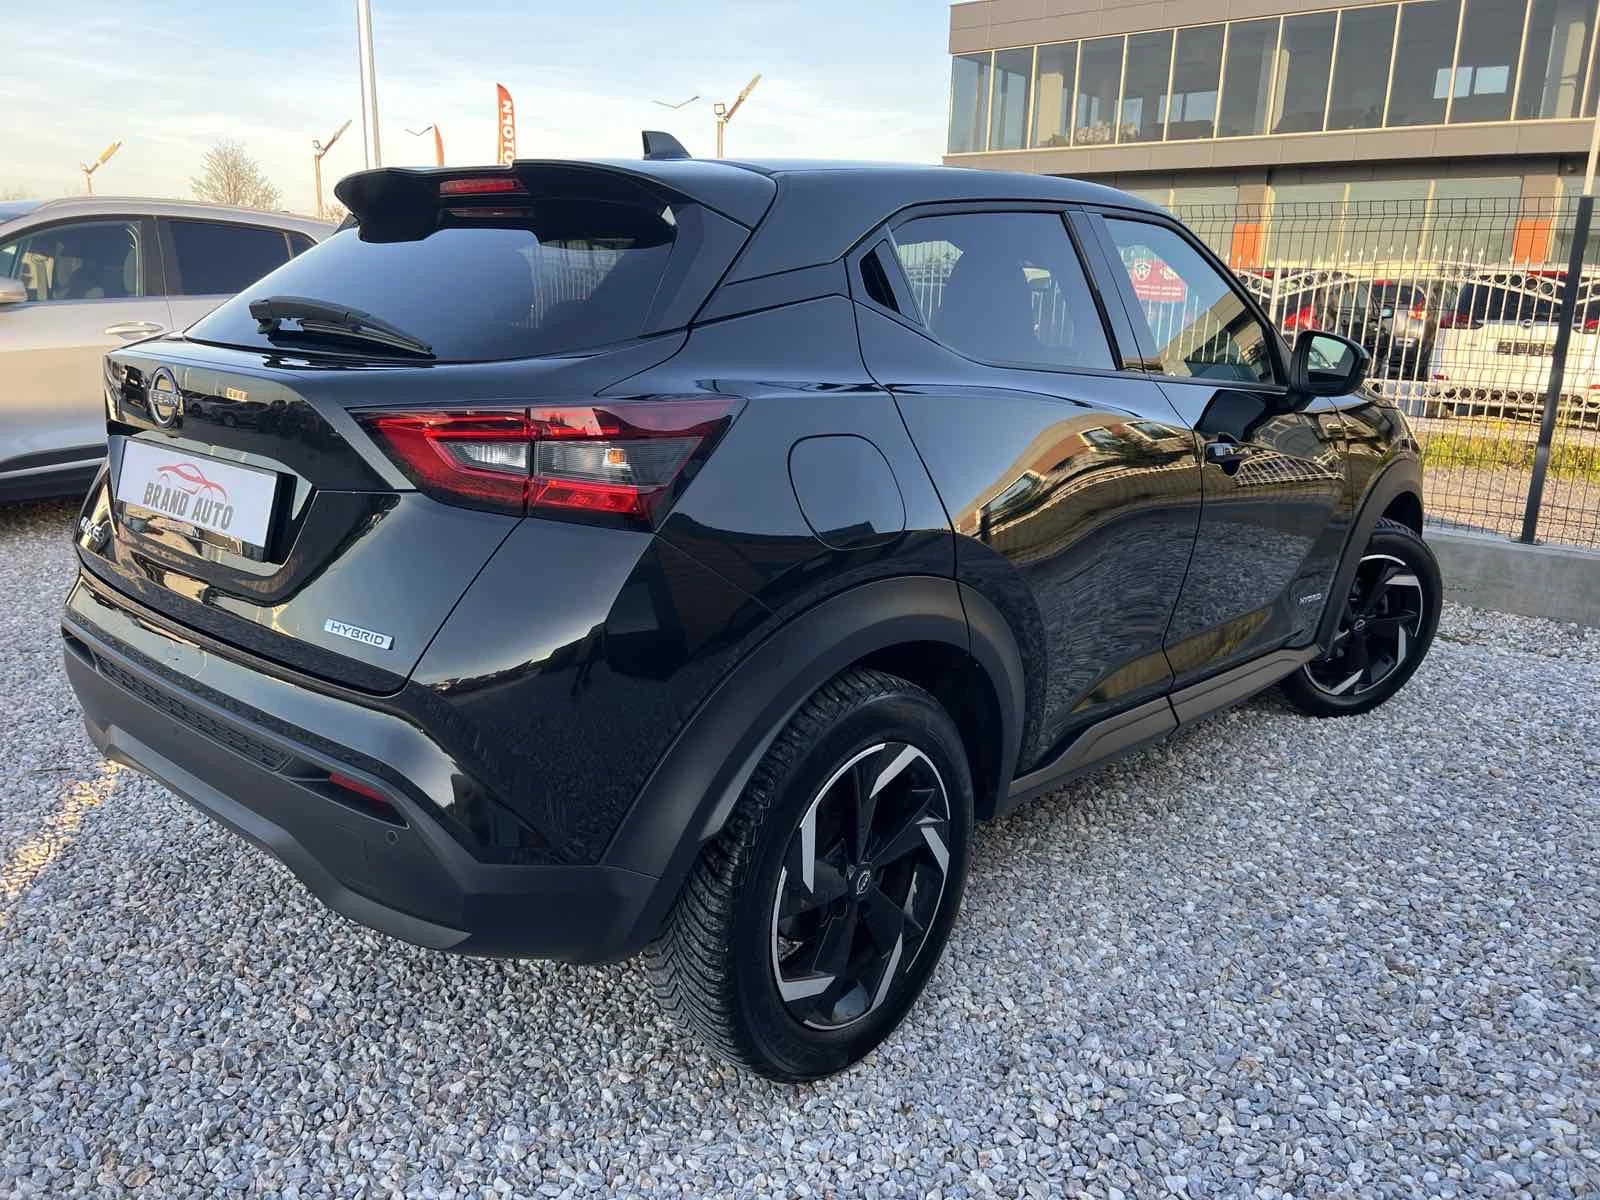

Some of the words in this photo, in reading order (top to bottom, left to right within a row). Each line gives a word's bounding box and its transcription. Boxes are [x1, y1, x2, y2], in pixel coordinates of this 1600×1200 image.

[143, 482, 190, 517] BRAND
[191, 496, 235, 530] AUTO
[330, 621, 385, 645] HYBRID
